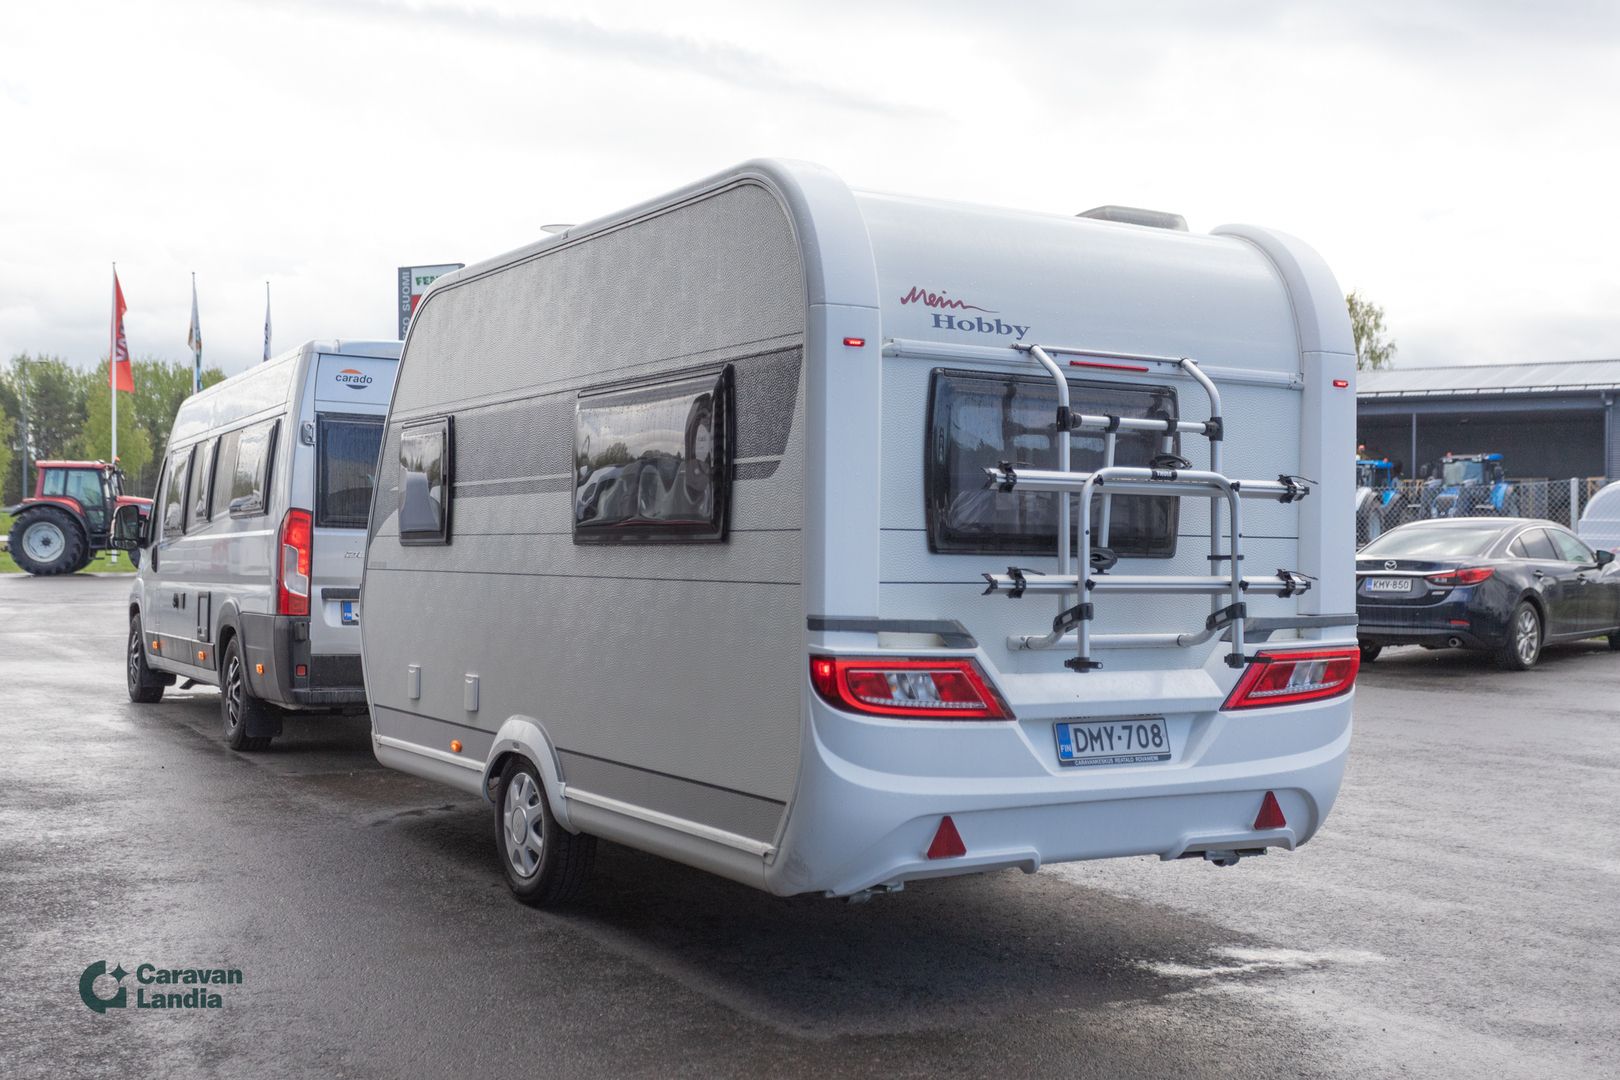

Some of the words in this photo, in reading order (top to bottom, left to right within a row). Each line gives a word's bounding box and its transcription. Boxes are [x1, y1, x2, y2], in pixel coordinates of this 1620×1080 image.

[402, 271, 410, 311] SUOMI
[901, 286, 985, 311] Mein
[931, 313, 1030, 340] Hobby
[335, 374, 373, 384] carado
[1060, 744, 1072, 752] FIN
